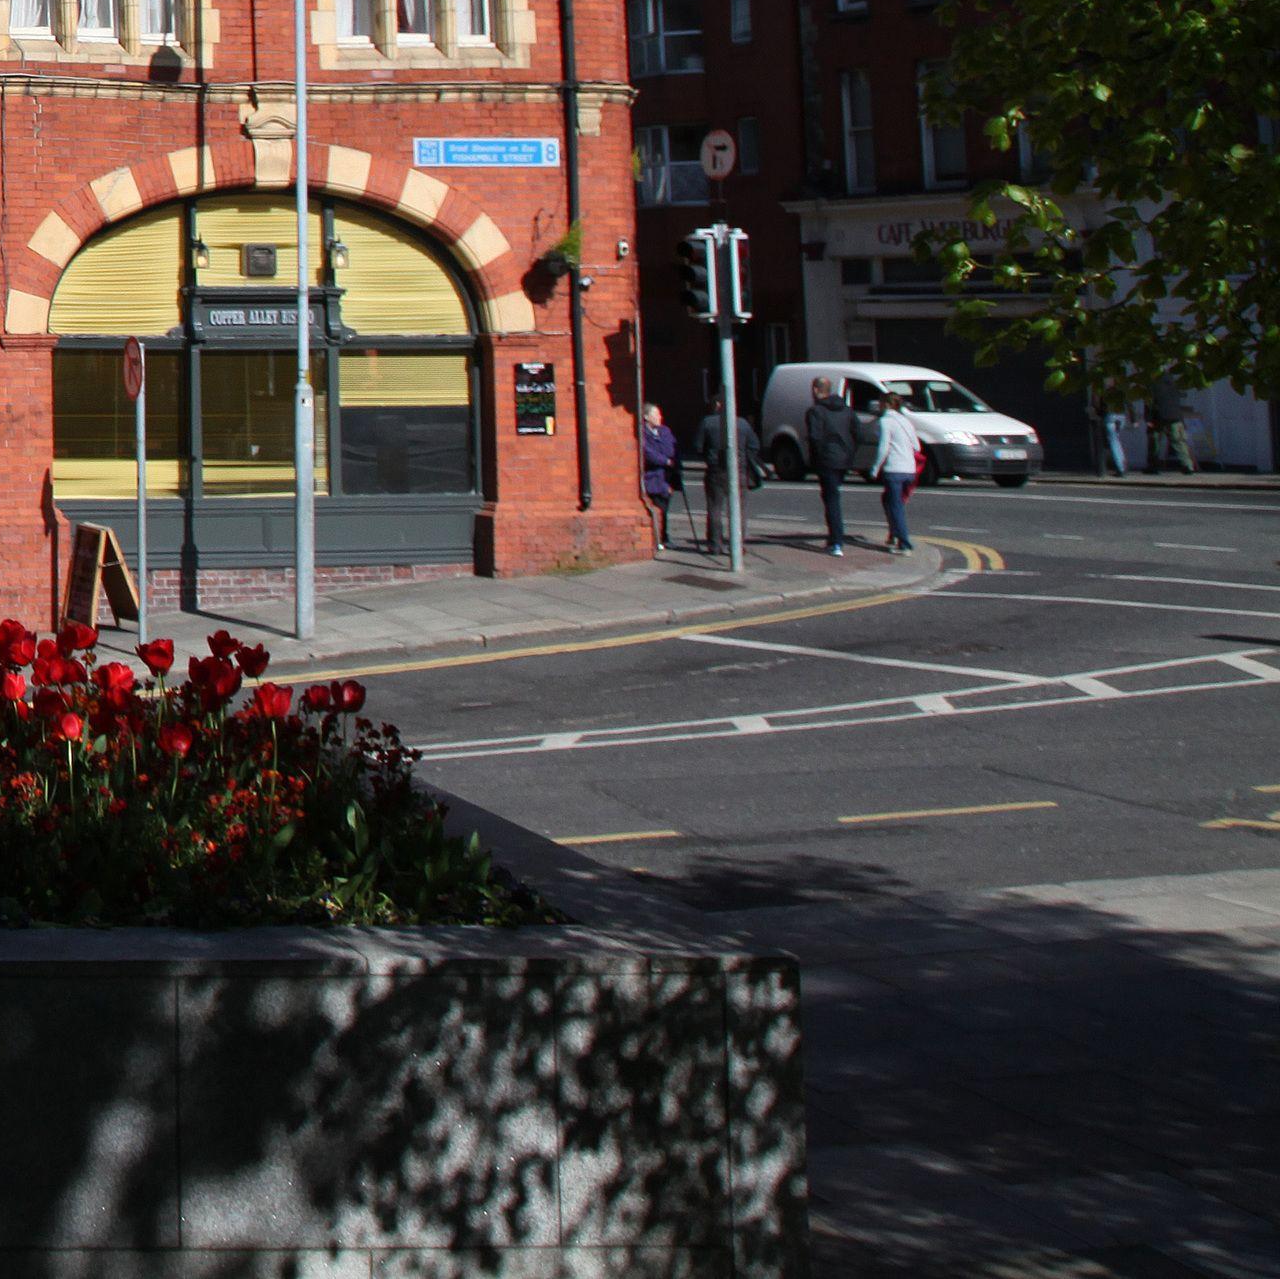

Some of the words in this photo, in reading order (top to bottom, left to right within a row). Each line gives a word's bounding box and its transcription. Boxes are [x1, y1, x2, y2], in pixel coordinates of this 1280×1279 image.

[502, 154, 534, 162] STREET
[546, 143, 556, 162] 8
[210, 309, 246, 326] COPPER
[248, 309, 279, 325] ALLEY
[280, 309, 315, 325] BISO
